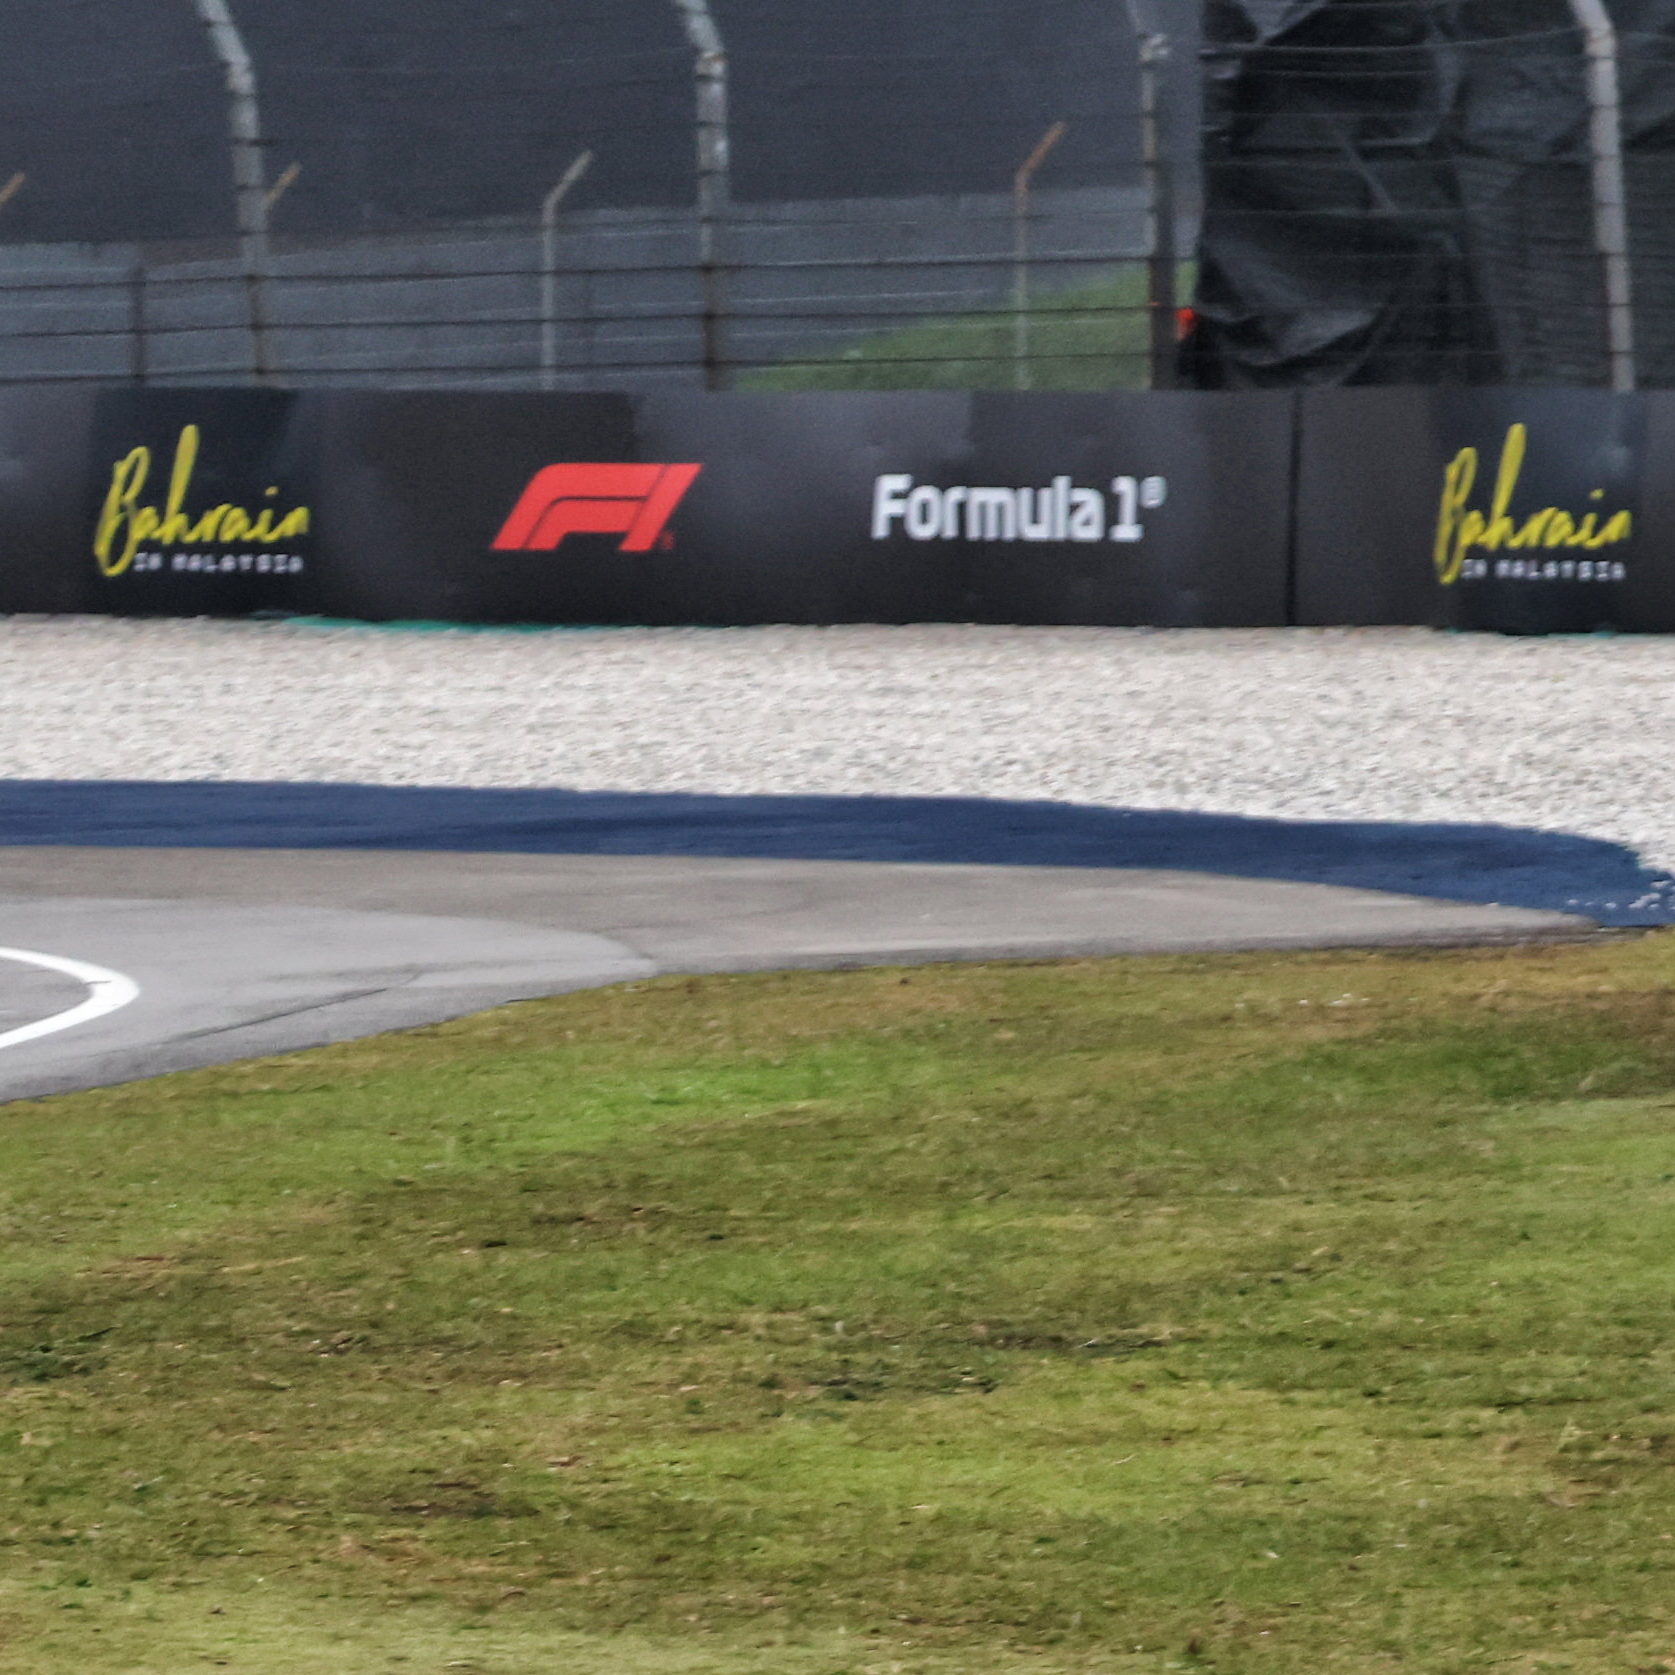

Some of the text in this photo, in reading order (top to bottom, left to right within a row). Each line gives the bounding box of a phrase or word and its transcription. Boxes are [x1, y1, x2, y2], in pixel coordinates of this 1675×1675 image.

[93, 424, 310, 577] Bahrain
[871, 473, 1105, 542] Formula
[1434, 422, 1632, 585] Bahrain
